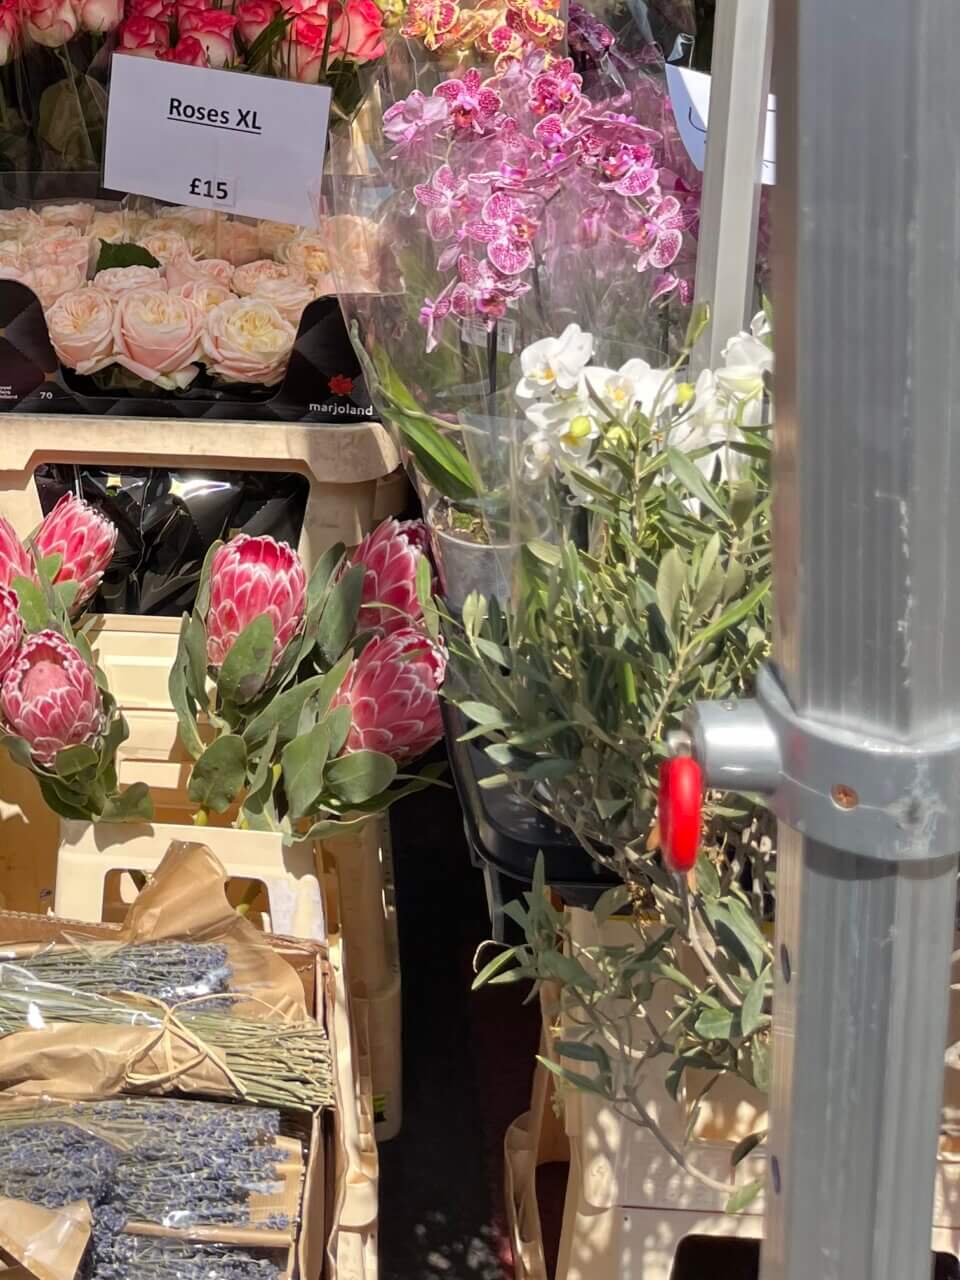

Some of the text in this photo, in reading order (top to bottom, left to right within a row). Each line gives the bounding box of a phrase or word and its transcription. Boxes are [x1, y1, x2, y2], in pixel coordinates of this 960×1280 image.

[168, 97, 263, 131] Roses XL
[188, 177, 229, 200] £15
[40, 391, 53, 400] 70
[308, 402, 374, 416] marjoland
